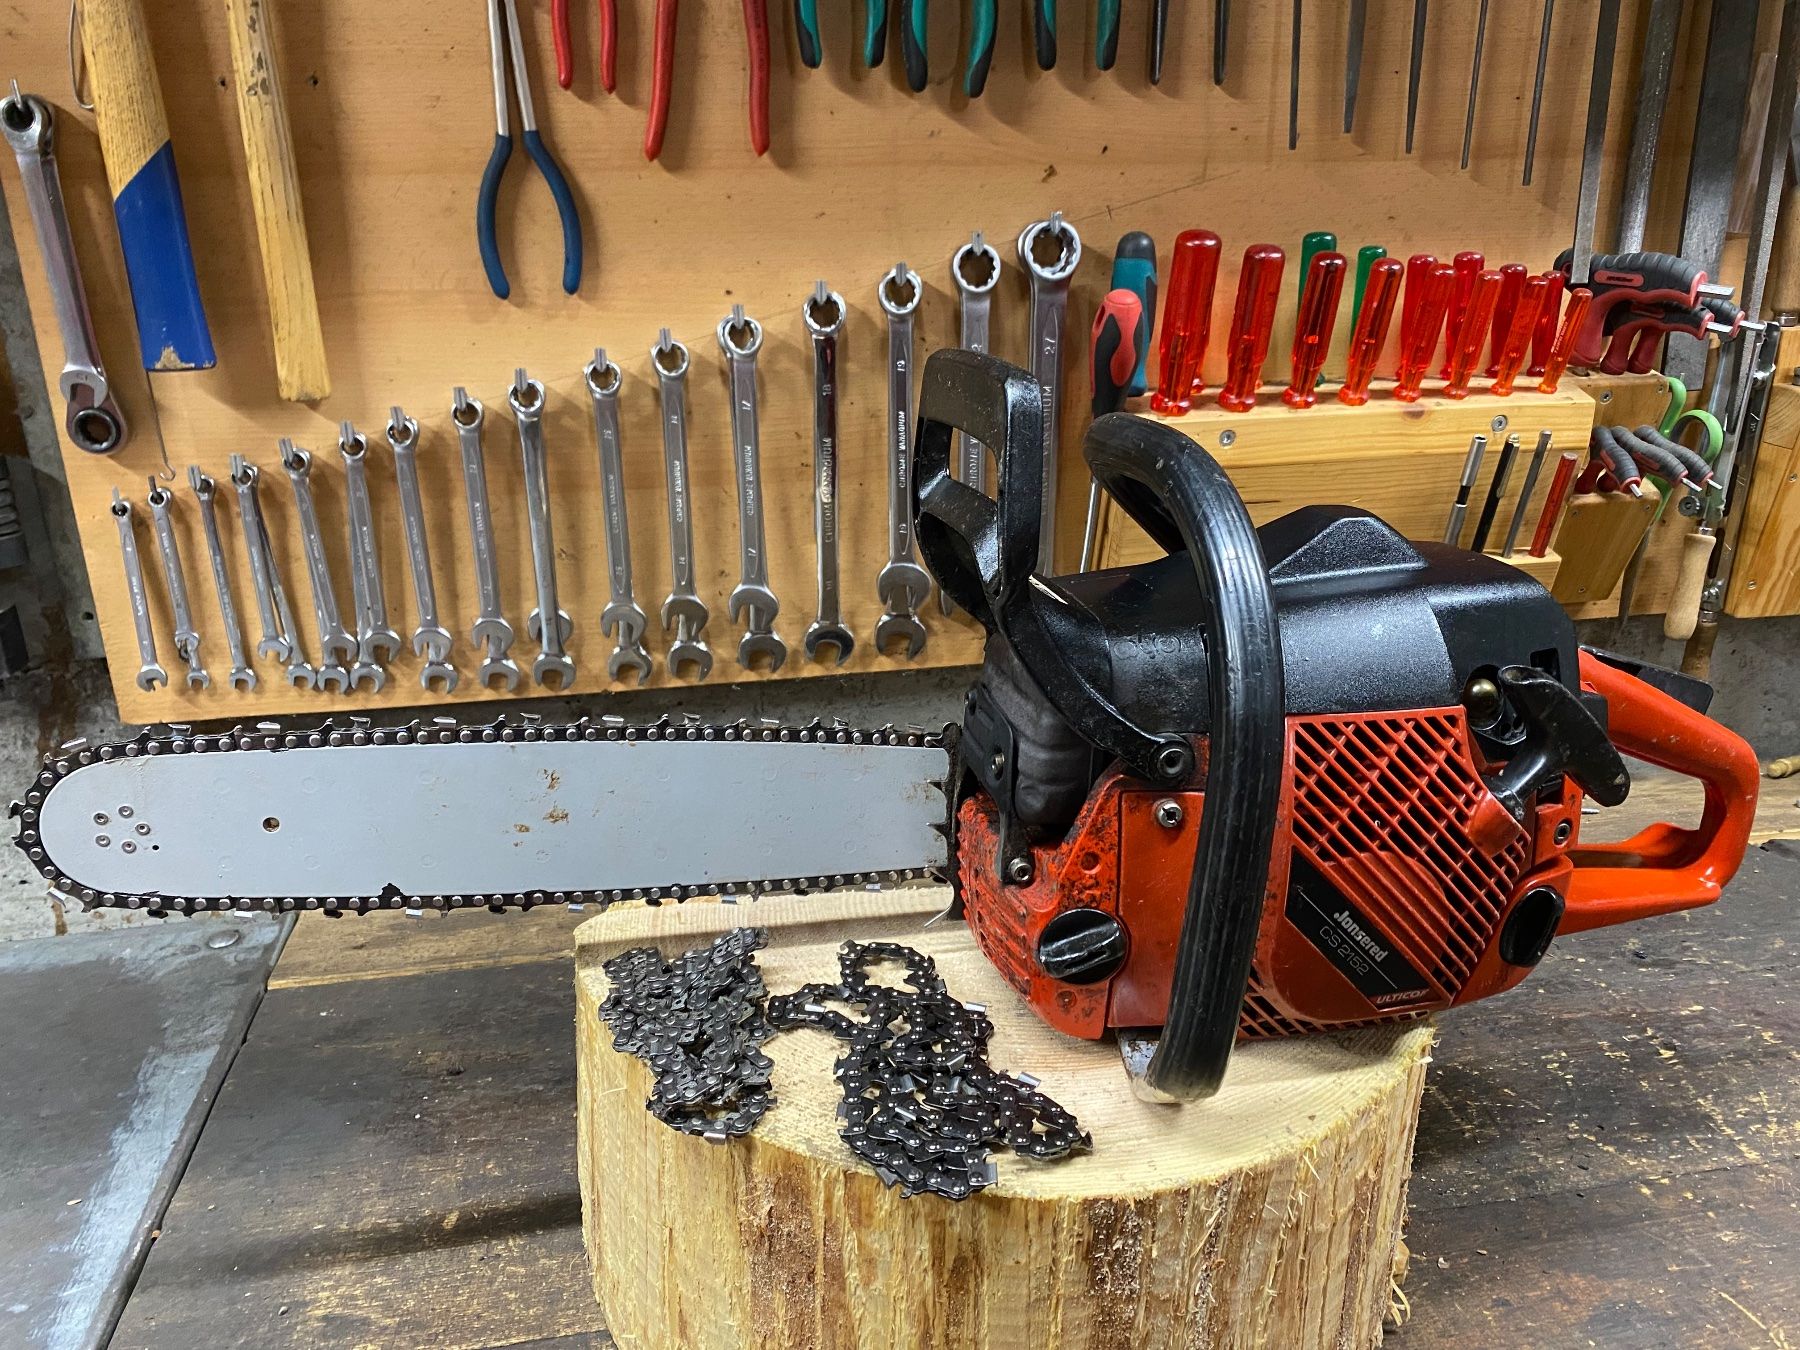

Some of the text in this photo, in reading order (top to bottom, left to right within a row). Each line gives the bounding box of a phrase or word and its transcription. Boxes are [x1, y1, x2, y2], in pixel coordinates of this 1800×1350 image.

[822, 384, 832, 396] 18
[896, 360, 906, 372] 19
[897, 410, 906, 488] CHROME VANADIUM
[968, 447, 978, 489] CHROME
[821, 437, 833, 543] CHROME VANADIUM
[1320, 925, 1369, 976] CS 2152
[1333, 910, 1389, 962] Jonsered
